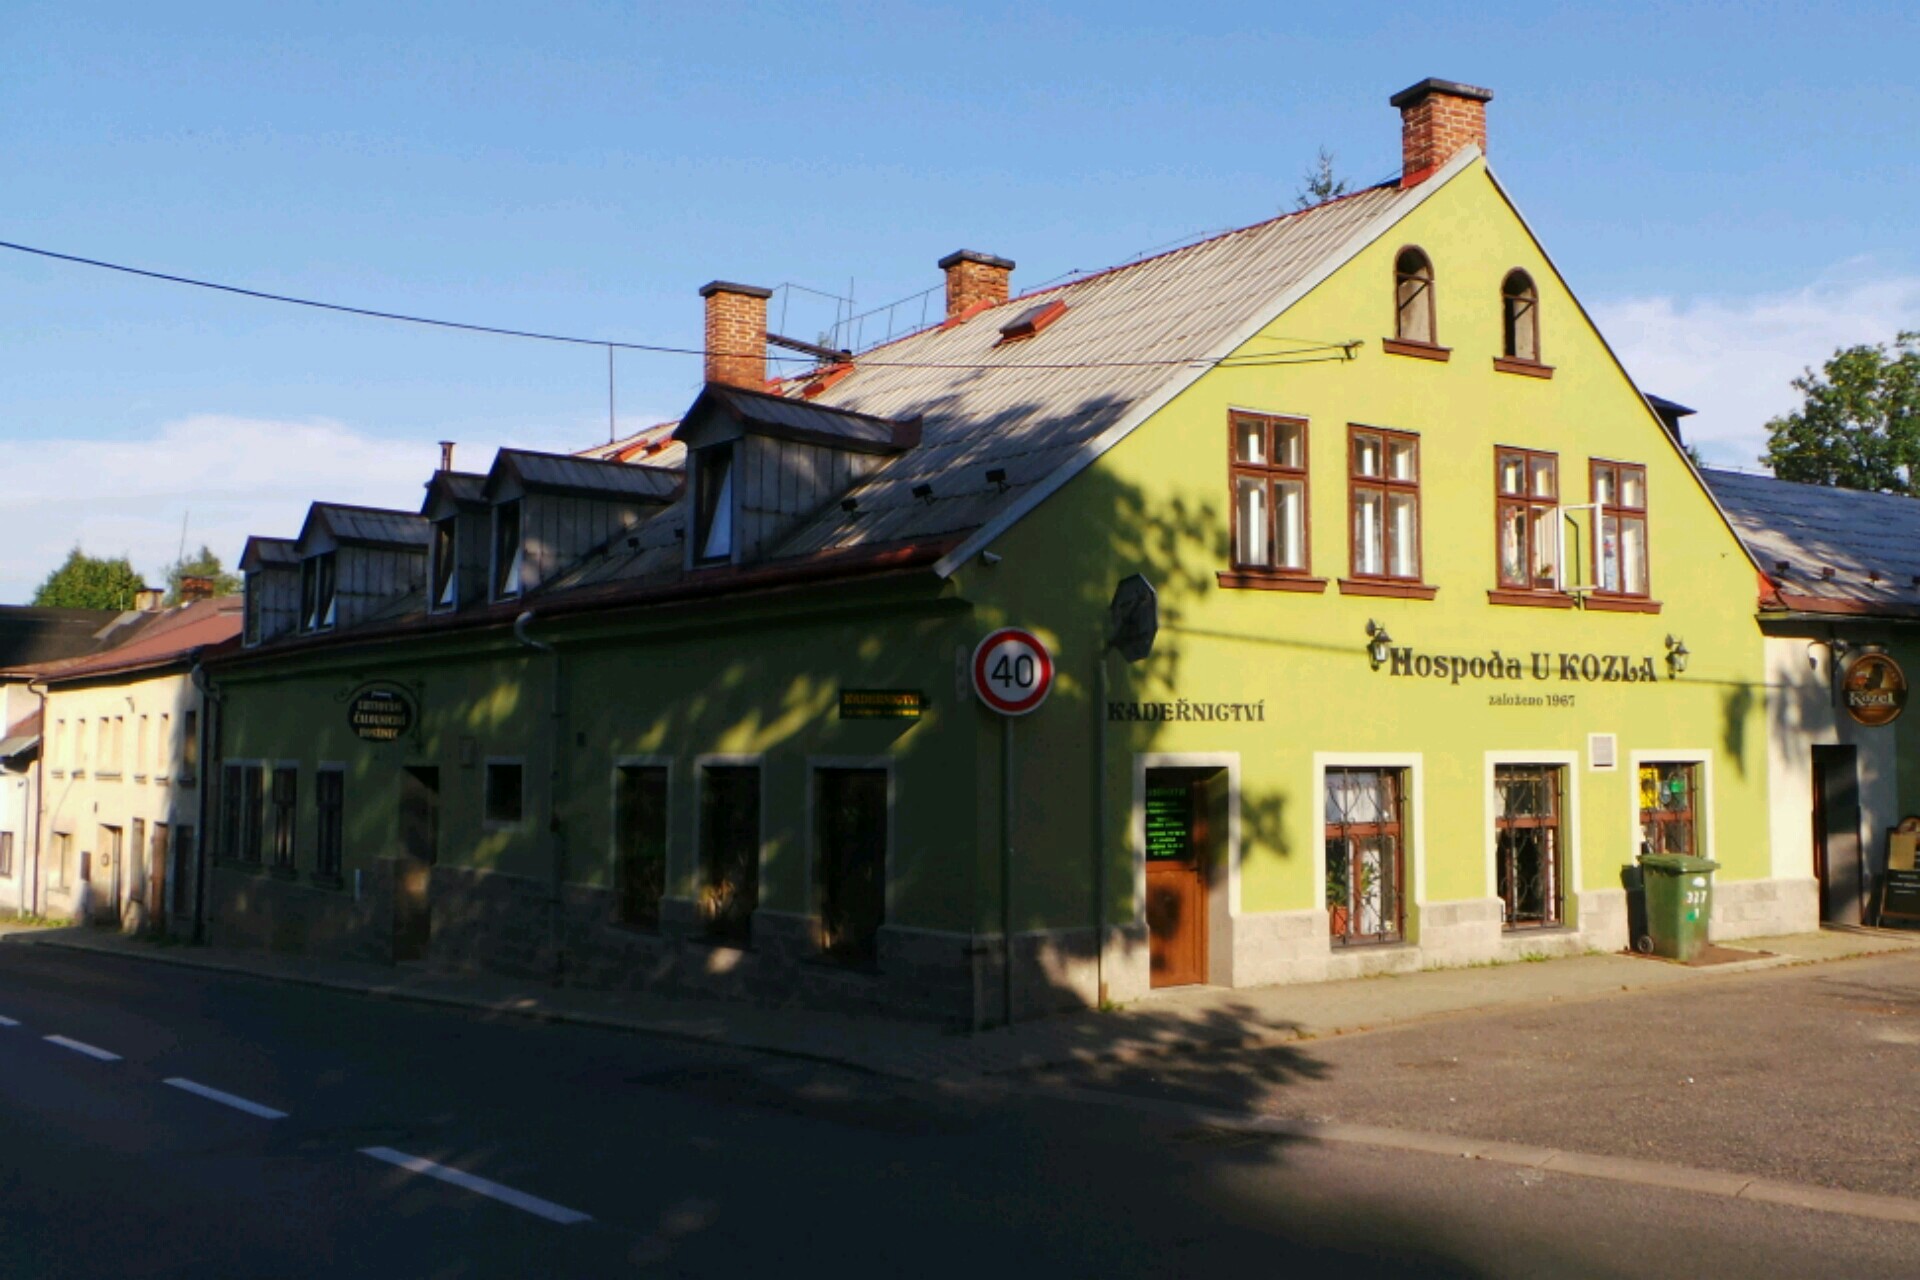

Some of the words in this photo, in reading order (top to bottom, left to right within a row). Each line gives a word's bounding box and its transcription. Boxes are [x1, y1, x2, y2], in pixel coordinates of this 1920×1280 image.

[991, 655, 1035, 689] 40
[1389, 646, 1522, 685] Hospoda
[1531, 652, 1550, 680] U
[1558, 652, 1658, 683] KOZLA
[1107, 698, 1265, 722] KADEŘNICTVÍ
[1488, 693, 1543, 706] založeno
[1546, 694, 1576, 707] 1967
[1849, 691, 1895, 706] Kozel
